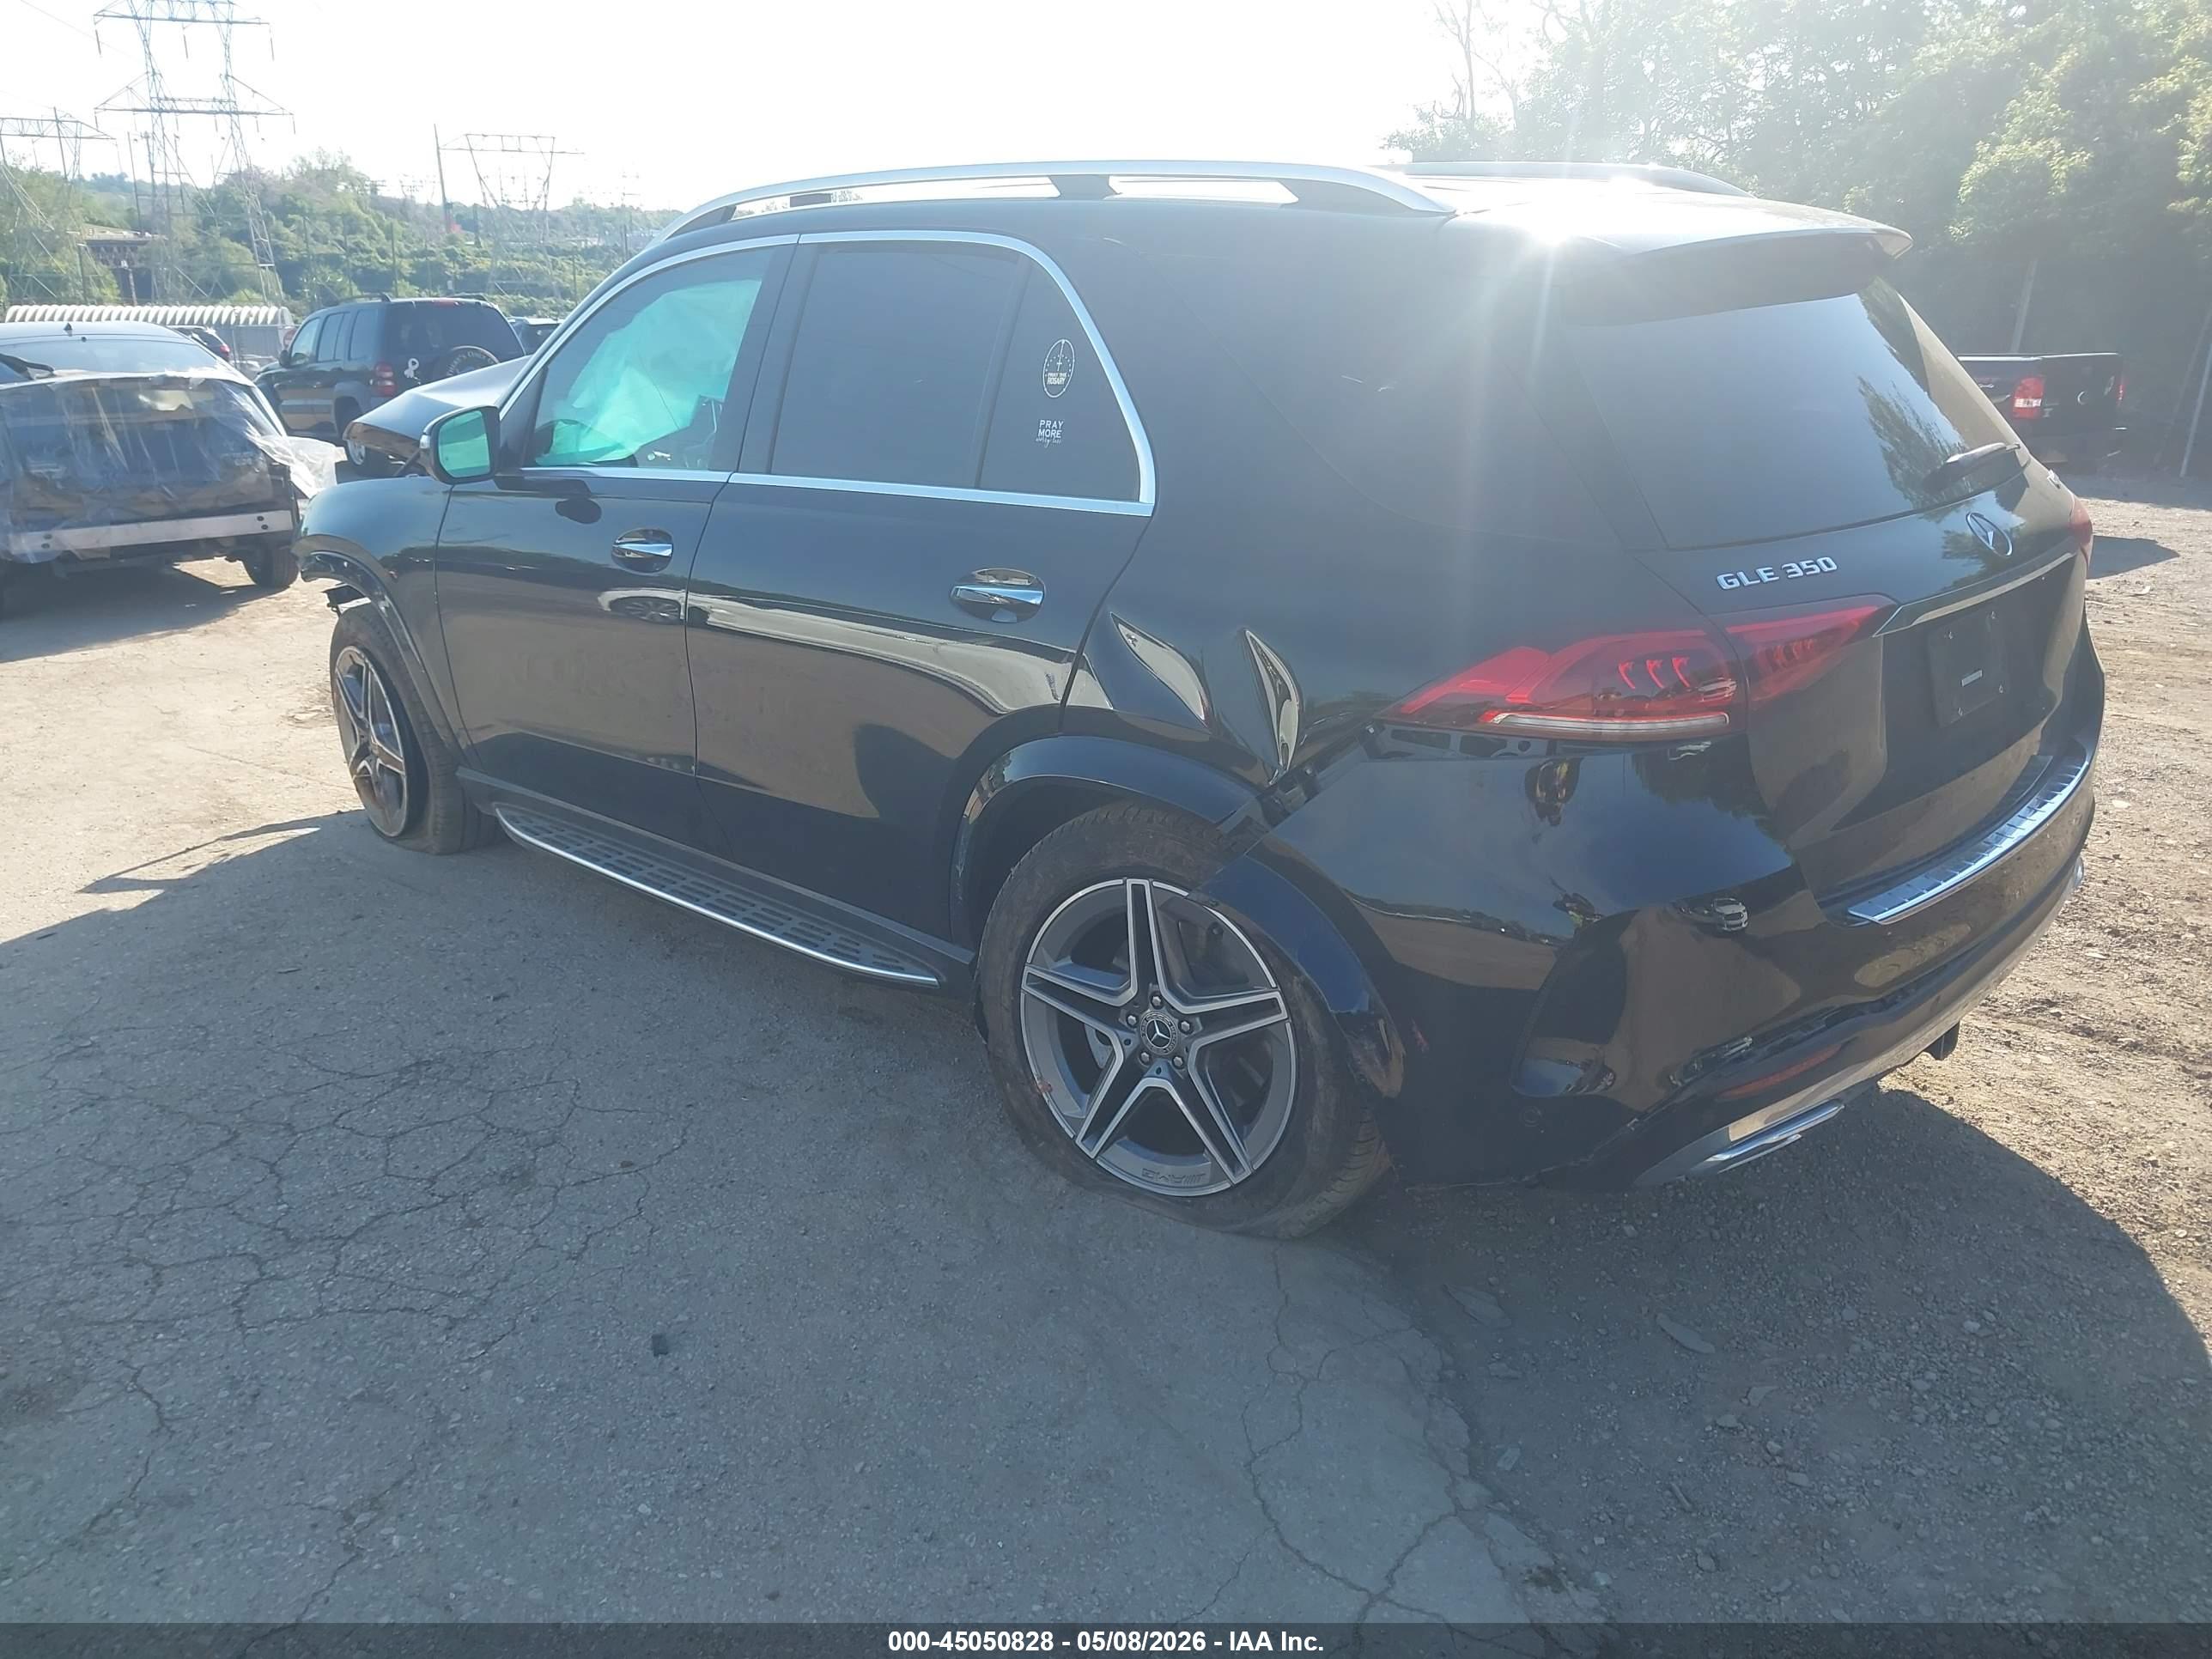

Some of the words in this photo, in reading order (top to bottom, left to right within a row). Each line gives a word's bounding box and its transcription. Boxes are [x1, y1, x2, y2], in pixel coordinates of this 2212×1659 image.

[1039, 419, 1064, 429] PRAY
[1038, 428, 1062, 439] MORE
[1717, 567, 1780, 590] GLE
[1781, 556, 1838, 579] 350
